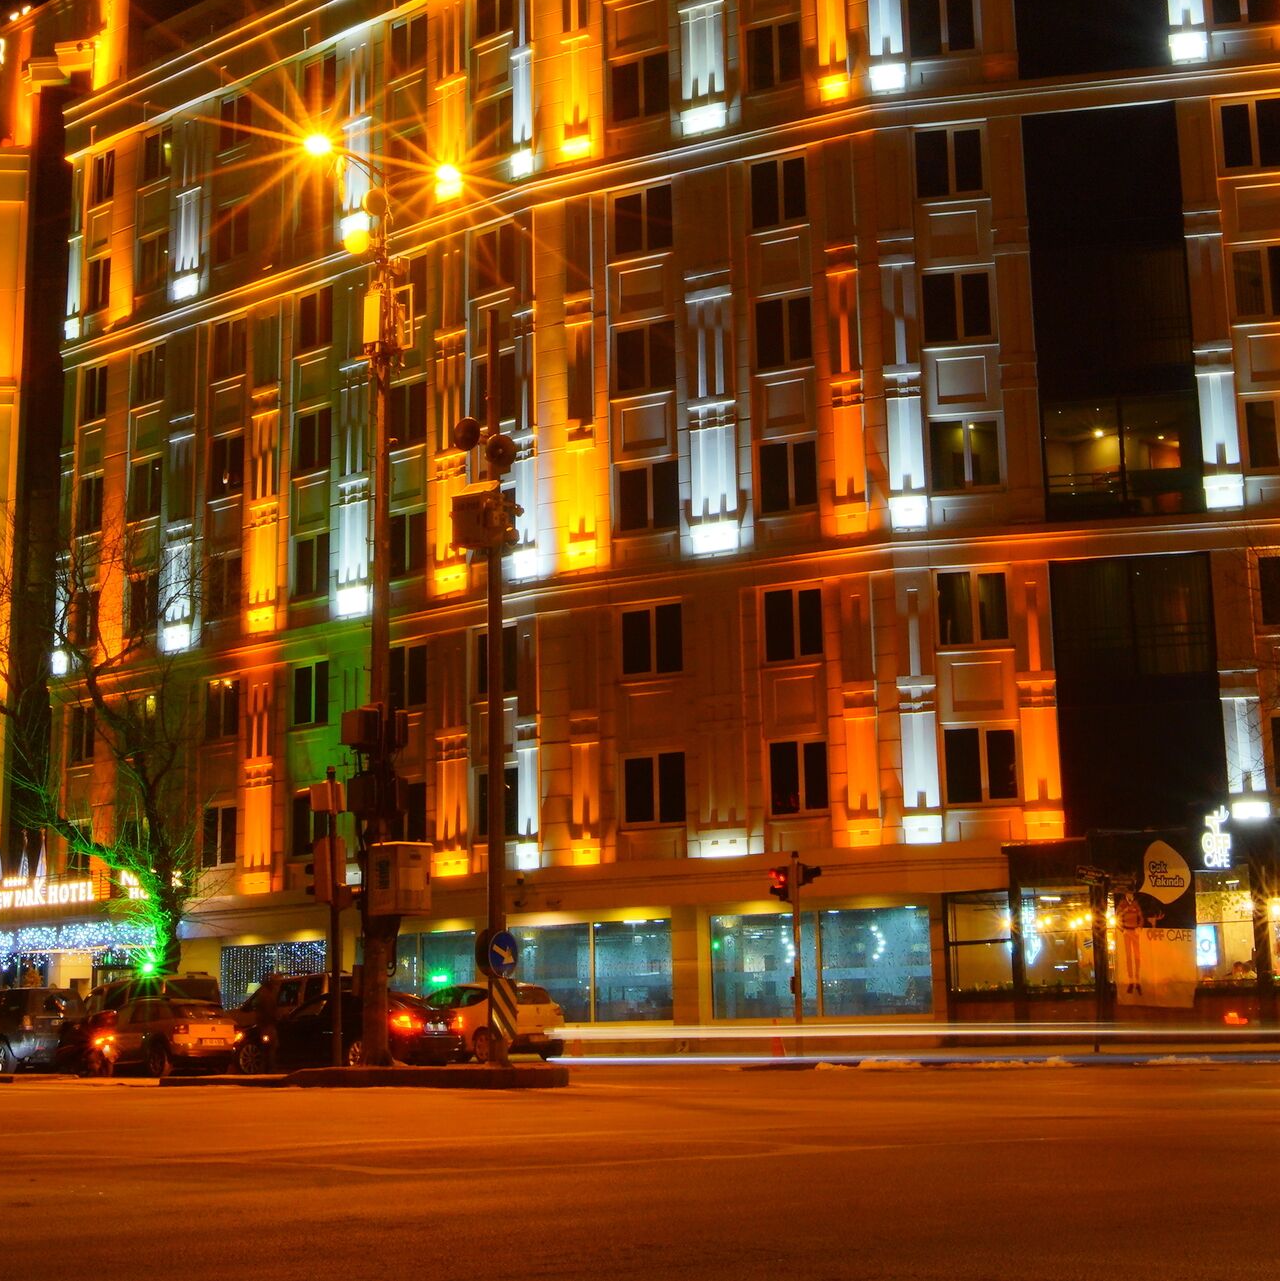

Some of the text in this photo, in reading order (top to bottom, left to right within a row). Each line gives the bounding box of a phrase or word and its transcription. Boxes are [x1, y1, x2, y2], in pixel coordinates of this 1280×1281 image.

[1204, 852, 1231, 868] CAFE
[1149, 861, 1168, 874] Çok
[1149, 875, 1184, 887] Yakında
[14, 877, 46, 907] PARK
[47, 881, 94, 904] HOTEL
[1166, 929, 1192, 942] CAFE
